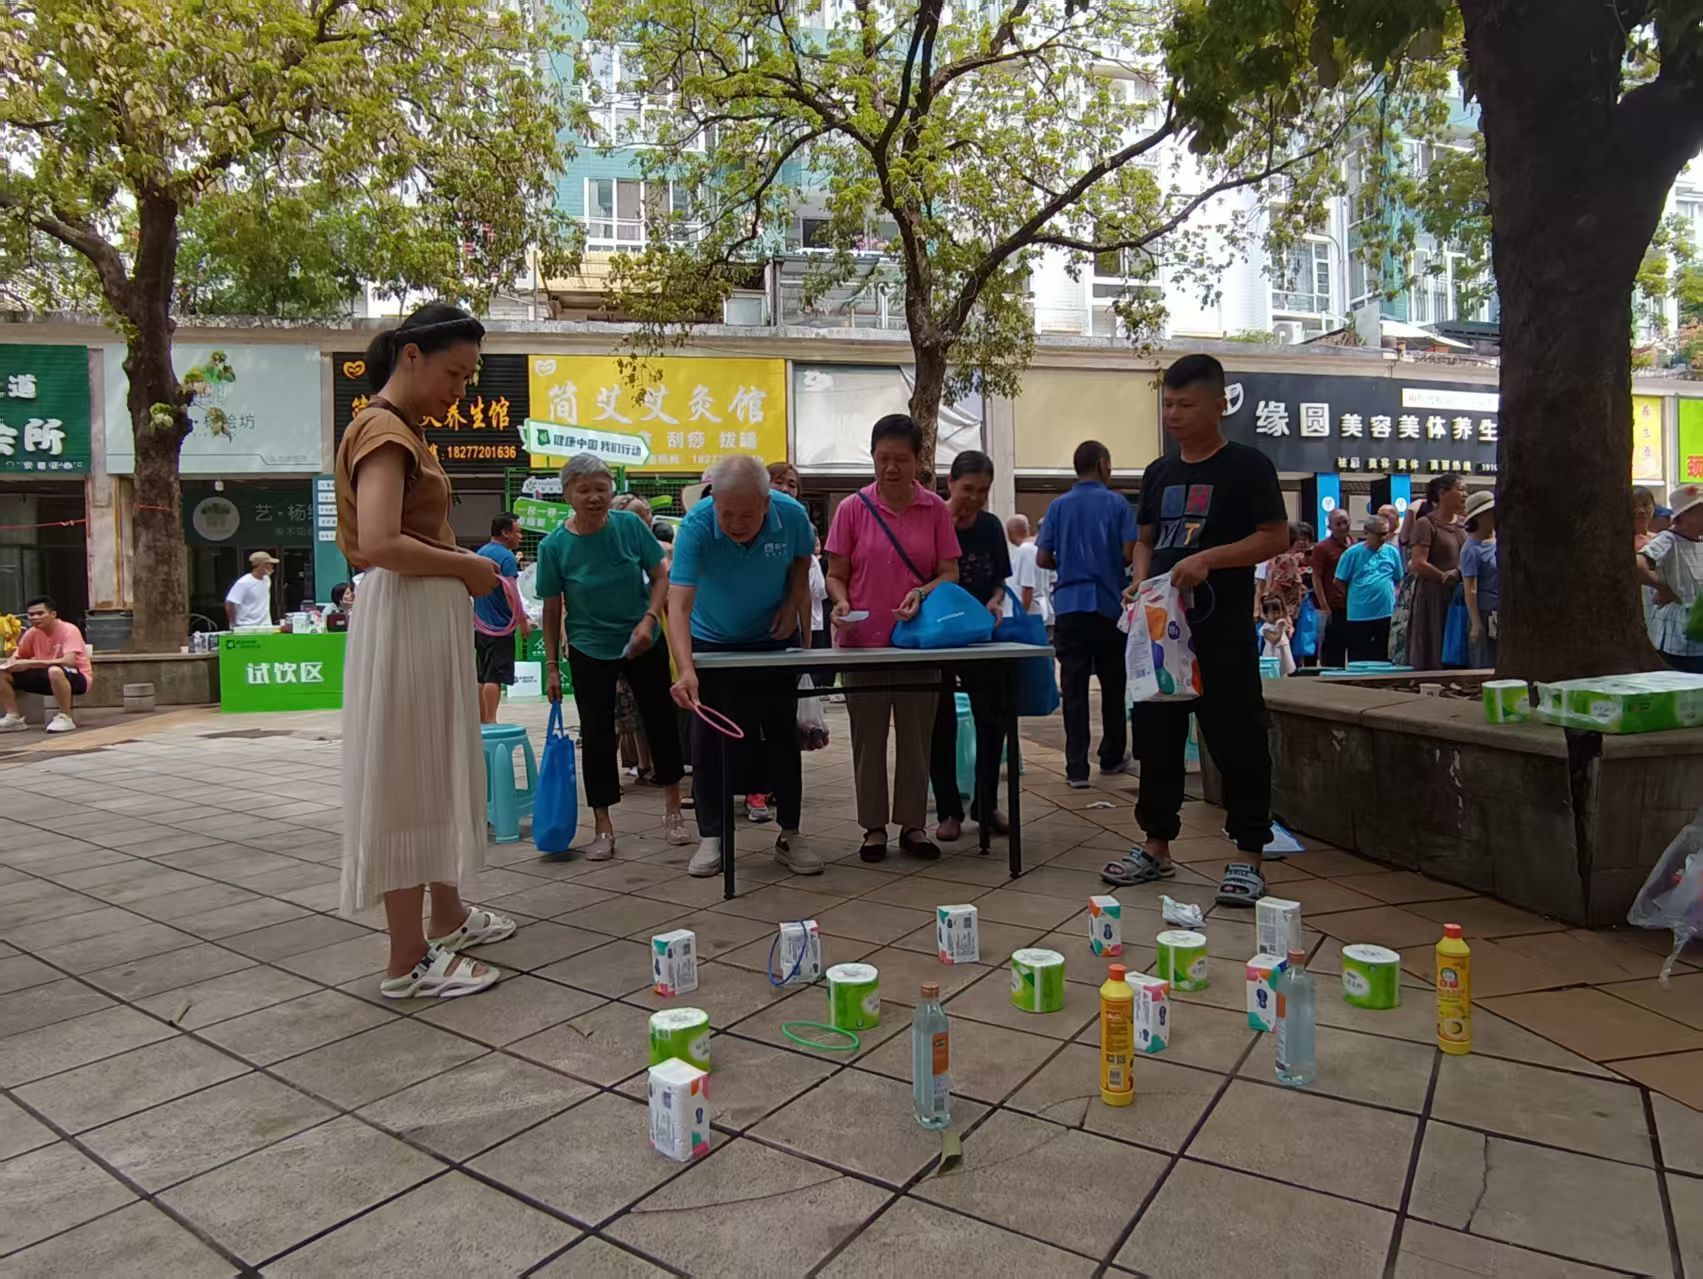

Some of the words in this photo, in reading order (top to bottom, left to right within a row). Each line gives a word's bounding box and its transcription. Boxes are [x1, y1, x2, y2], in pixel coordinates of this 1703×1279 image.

[1255, 401, 1330, 437] 缘圆
[553, 434, 598, 451] 健康中国
[600, 441, 642, 457] 我们行动
[246, 662, 324, 684] 试饮区
